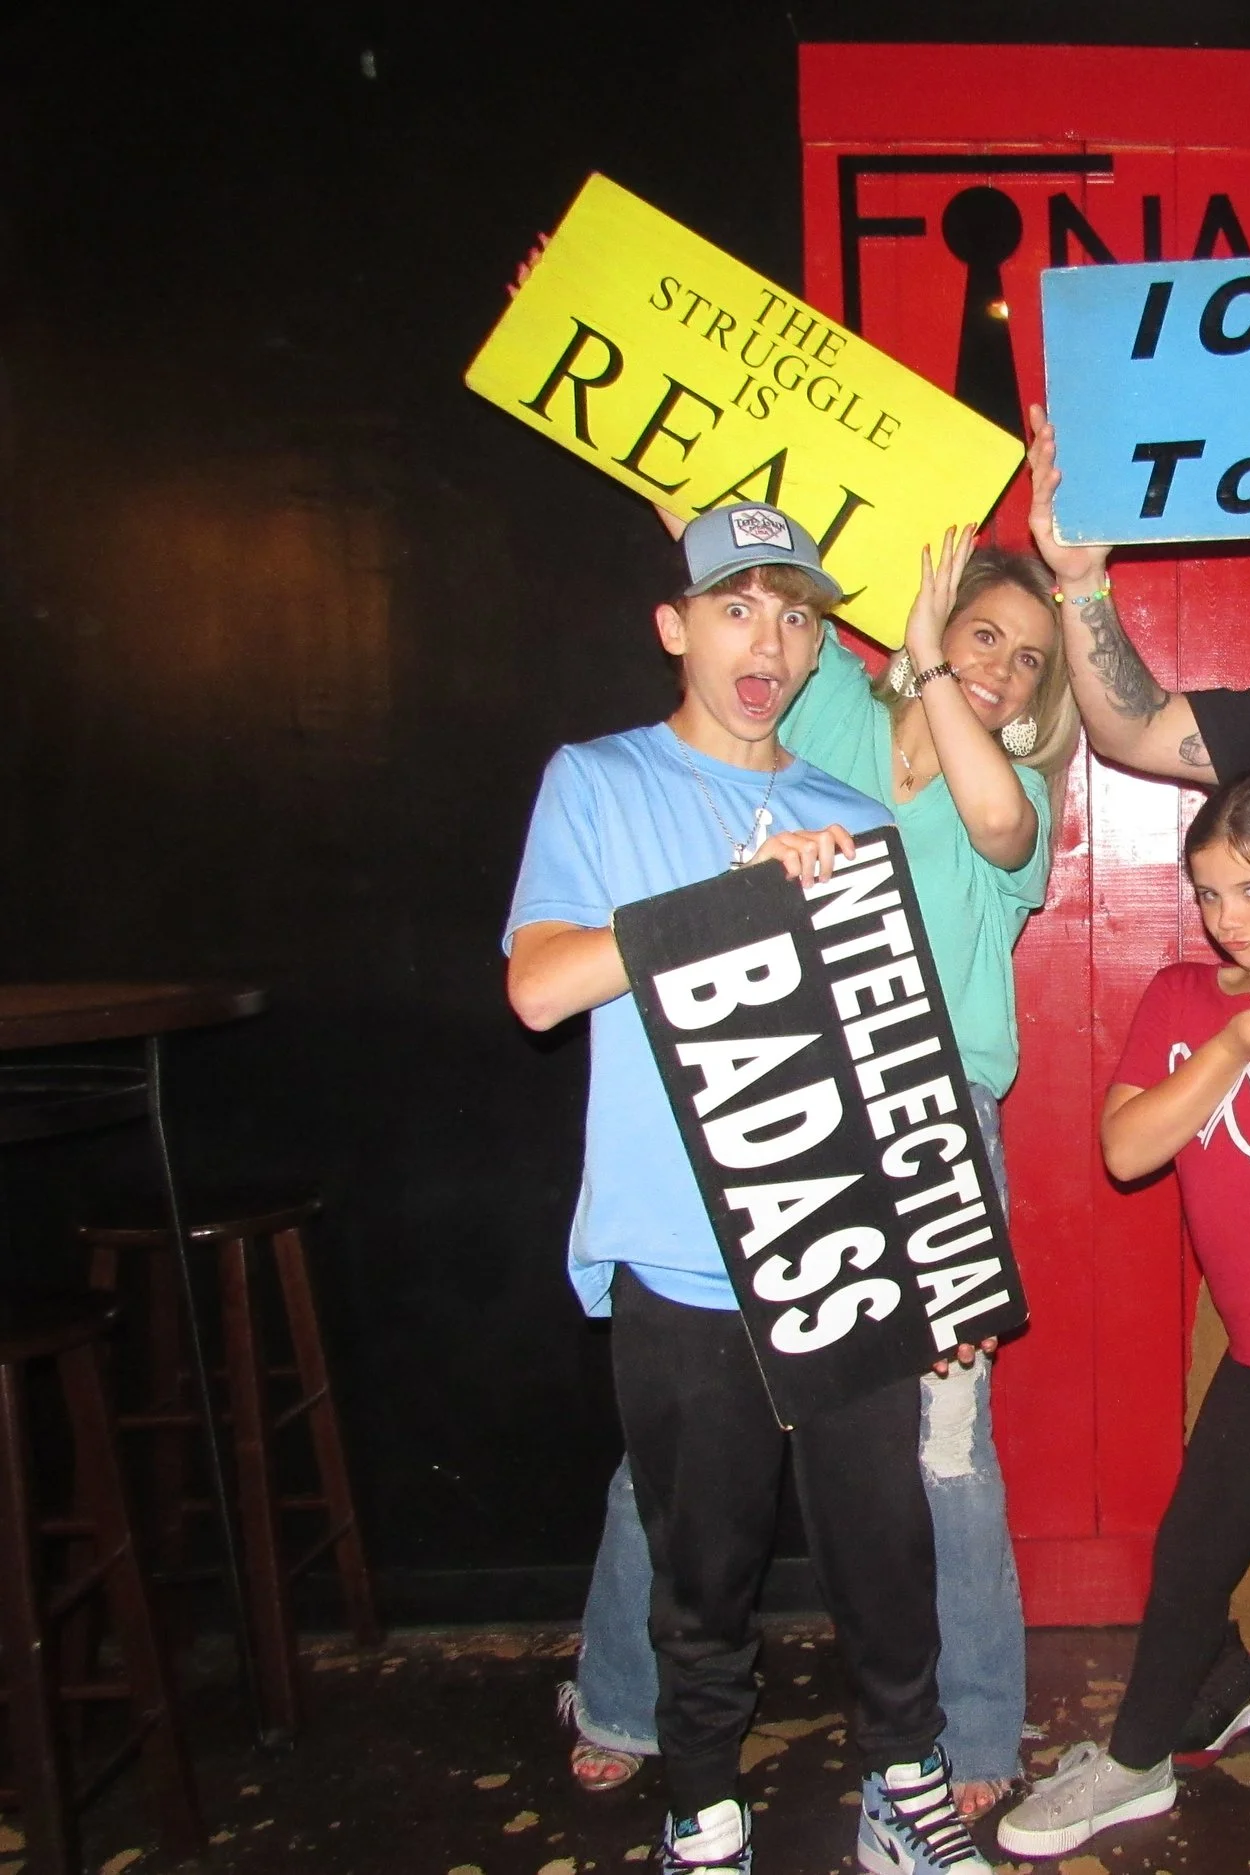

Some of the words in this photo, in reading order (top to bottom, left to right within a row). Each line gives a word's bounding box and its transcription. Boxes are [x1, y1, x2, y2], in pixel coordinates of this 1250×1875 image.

[648, 276, 901, 451] STRUGGLE
[730, 375, 778, 419] IS
[754, 288, 848, 368] THE
[1131, 282, 1173, 360] I
[518, 316, 875, 604] REAL
[652, 931, 901, 1355] BADASS
[803, 841, 1010, 1353] INTELLECTUAL
